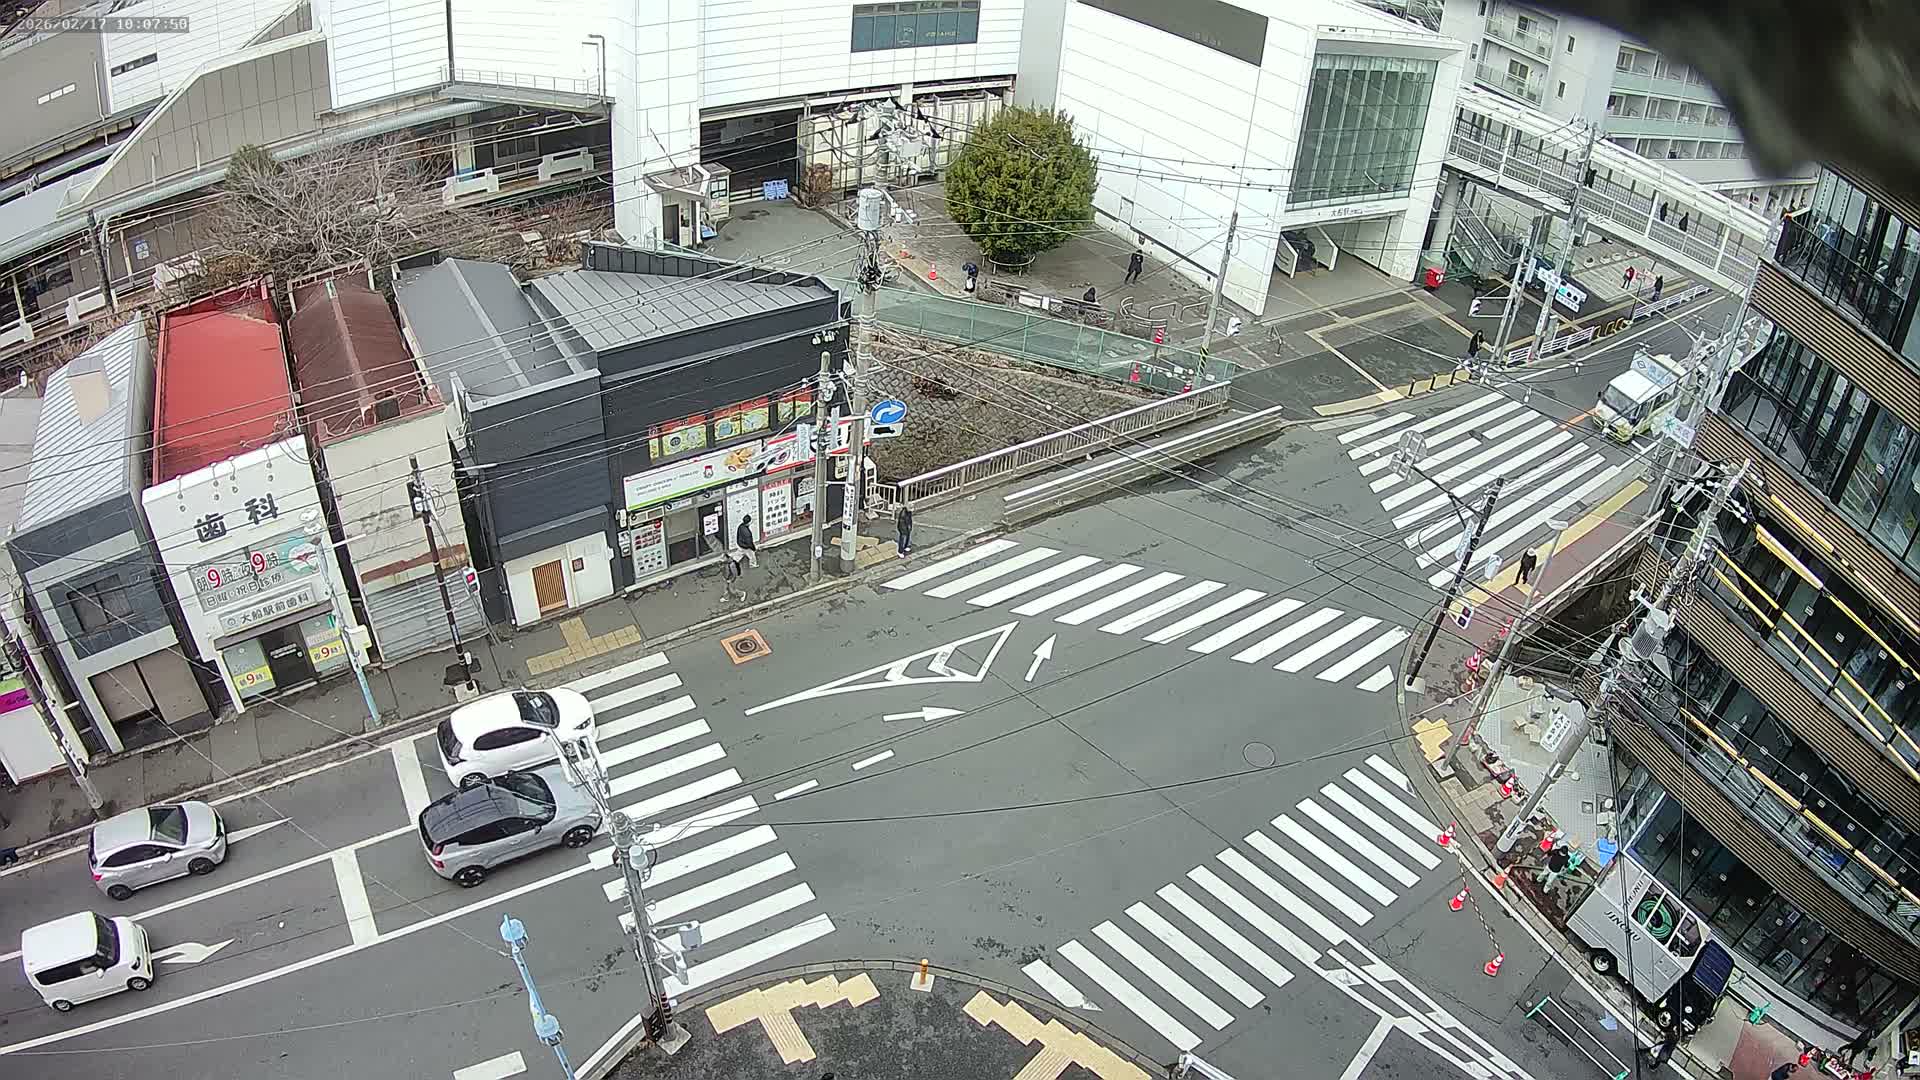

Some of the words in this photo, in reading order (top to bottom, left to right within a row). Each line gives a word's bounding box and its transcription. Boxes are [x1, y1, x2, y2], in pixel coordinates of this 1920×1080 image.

[193, 493, 279, 543] 歯科
[240, 591, 309, 624] 大船駅前歯科
